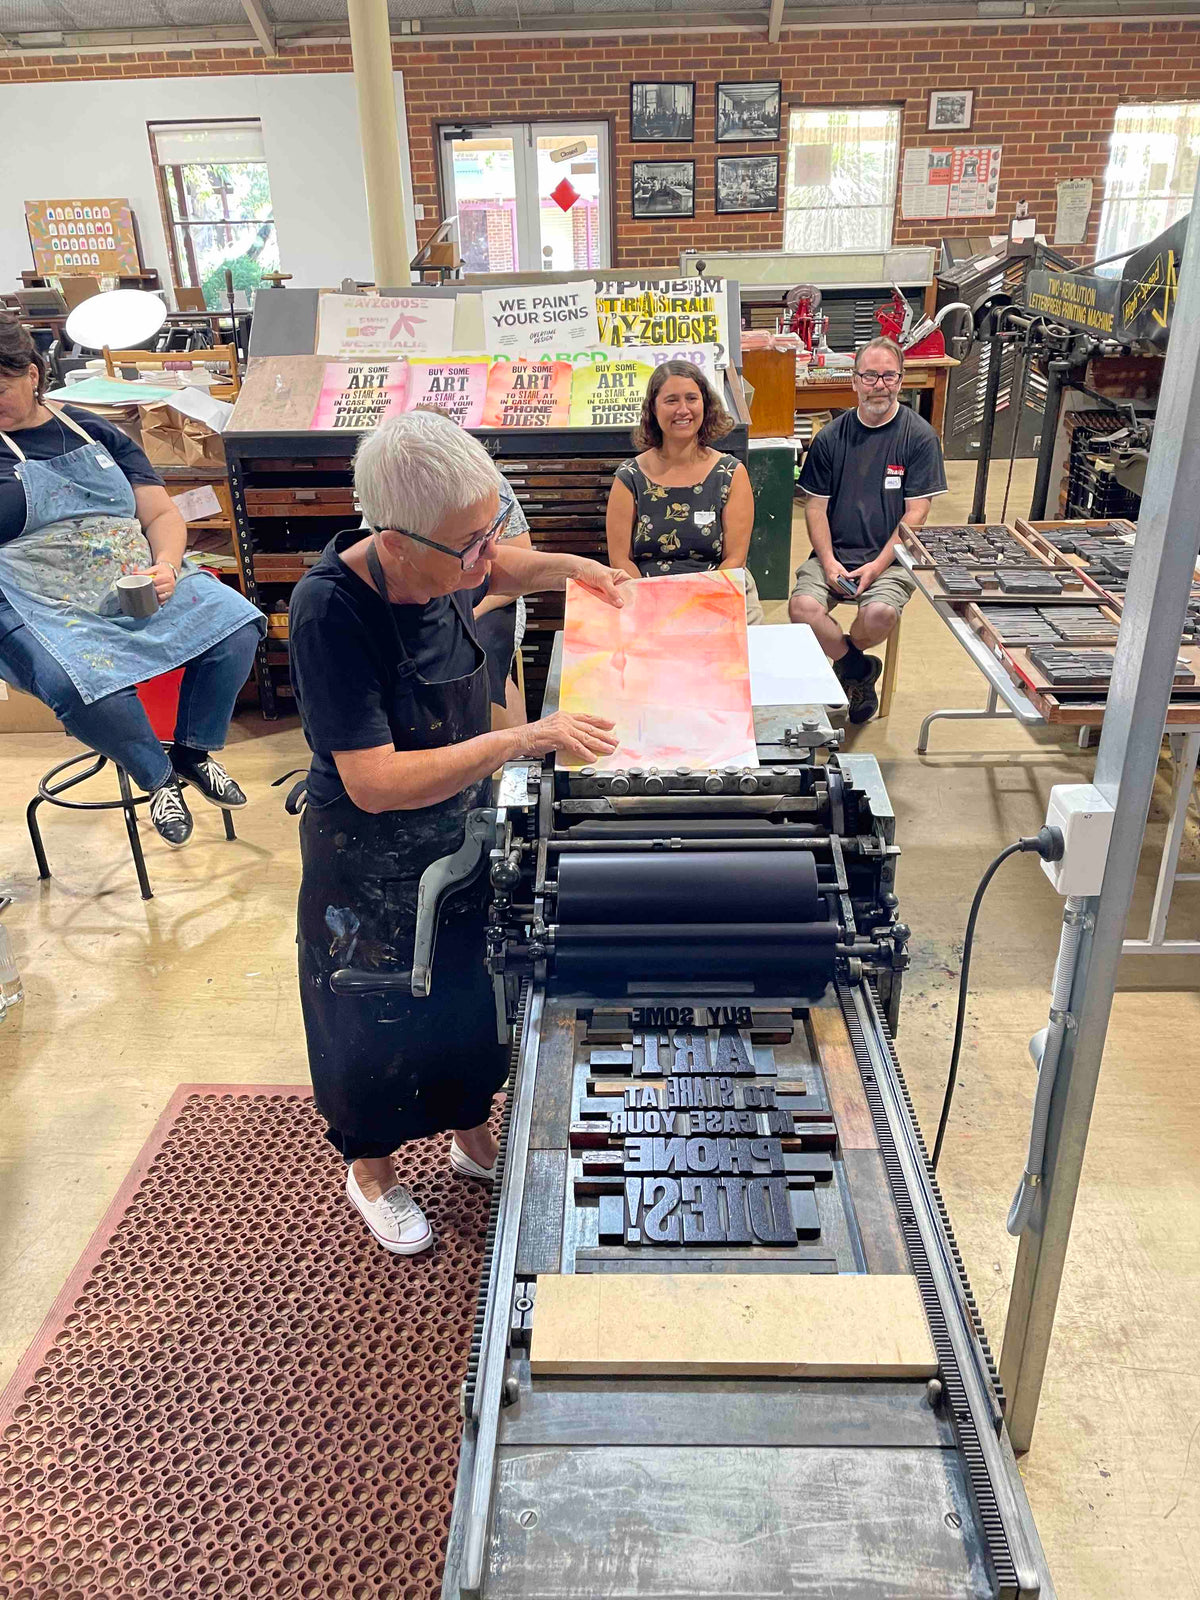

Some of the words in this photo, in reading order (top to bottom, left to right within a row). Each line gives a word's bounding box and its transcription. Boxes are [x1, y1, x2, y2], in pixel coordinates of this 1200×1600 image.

[499, 299, 526, 312] WE
[532, 294, 578, 309] PAINT
[492, 312, 539, 327] YOUR
[543, 306, 589, 322] SIGNS
[1029, 292, 1062, 317] LETTERPRESS
[1061, 302, 1087, 324] PRINTING
[1086, 308, 1114, 332] MACHINE
[532, 365, 553, 373] SOME
[347, 374, 388, 389] ART
[428, 376, 469, 392] ART
[512, 374, 552, 389] ART
[597, 372, 637, 389] ART
[352, 390, 374, 399] STARE
[434, 392, 455, 401] STARE
[519, 390, 539, 398] STARE
[604, 389, 625, 398] STARE
[336, 406, 386, 414] PHONE
[592, 404, 640, 412] PHONE
[501, 414, 551, 426] DIES!
[591, 412, 642, 426] DIES!
